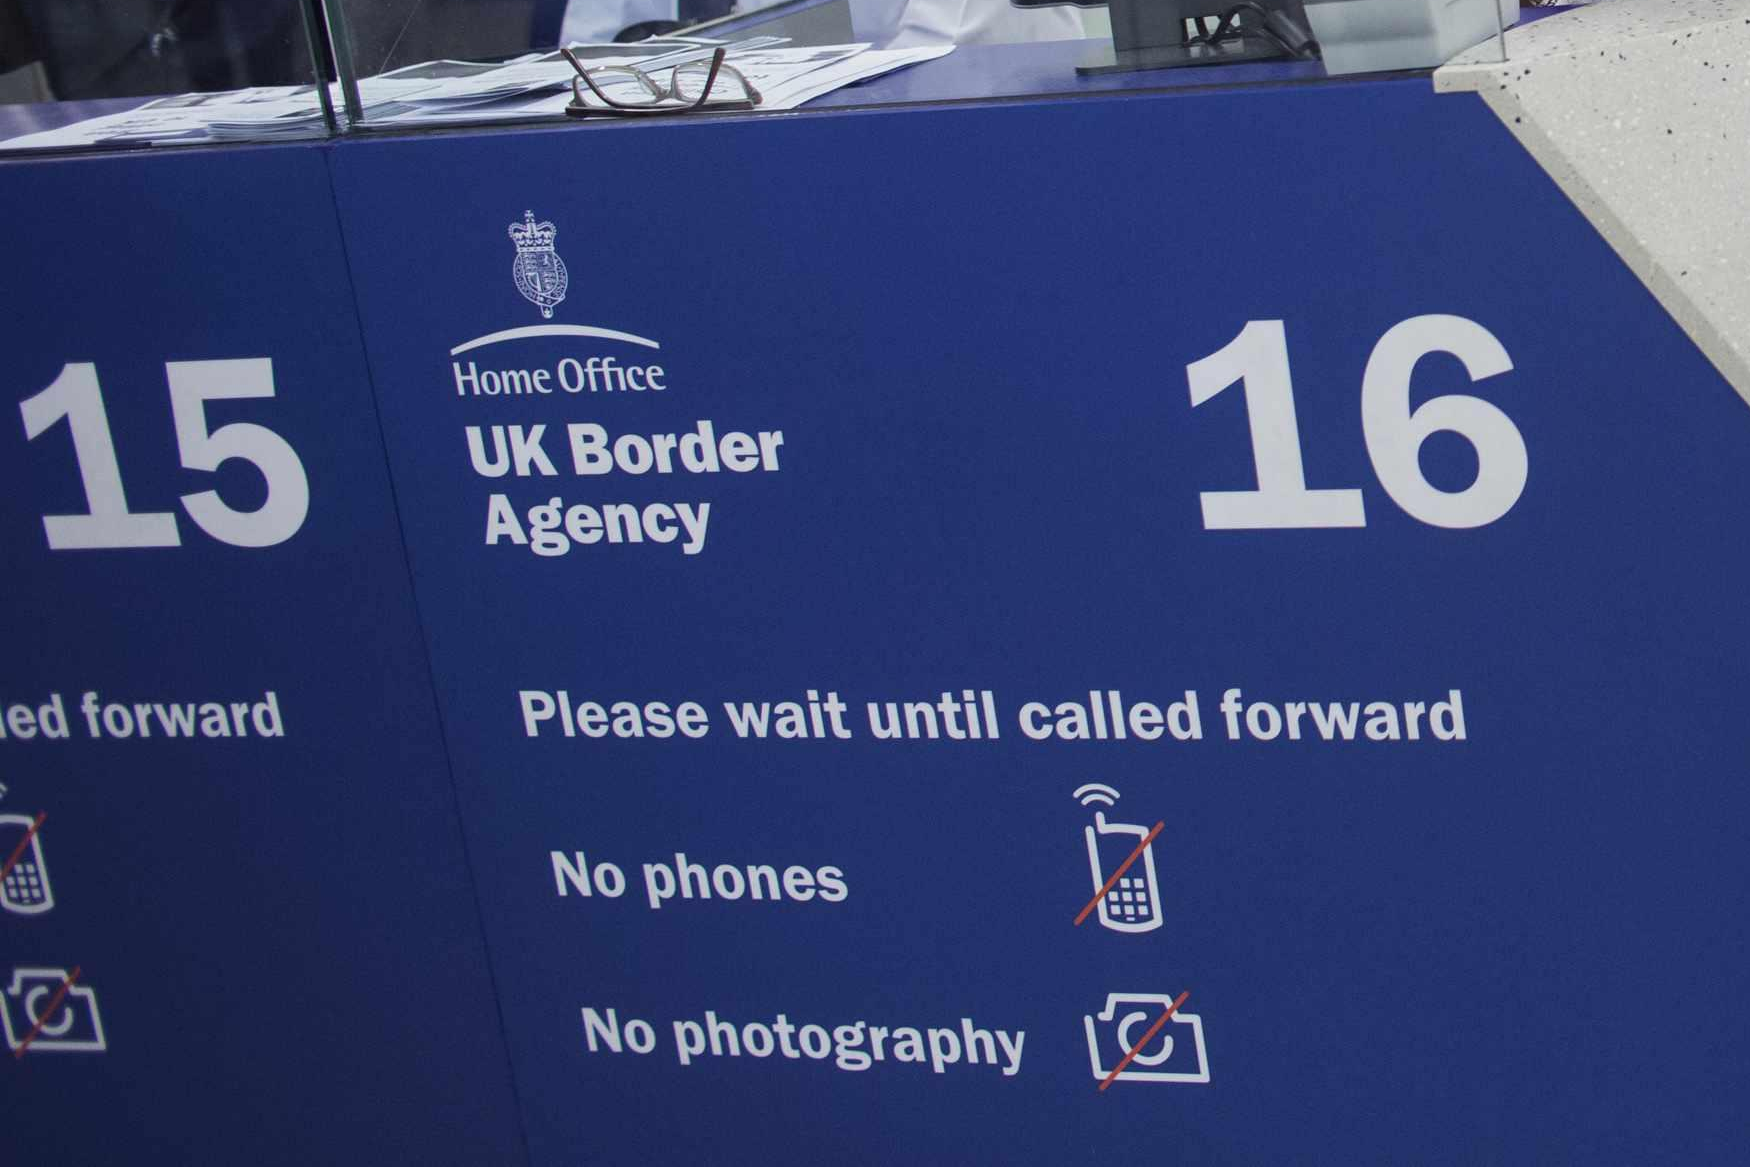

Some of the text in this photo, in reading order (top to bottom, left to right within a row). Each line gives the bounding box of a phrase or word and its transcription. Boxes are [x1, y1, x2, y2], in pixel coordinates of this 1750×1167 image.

[453, 357, 667, 396] Home Office
[466, 420, 784, 478] UK Border
[1187, 313, 1529, 530] 16
[20, 357, 310, 550] 15
[486, 493, 711, 557] Agency
[81, 691, 285, 739] forward
[519, 688, 1467, 741] Please wait until called forward
[551, 850, 849, 909] No phones
[581, 1007, 1026, 1076] No photography
